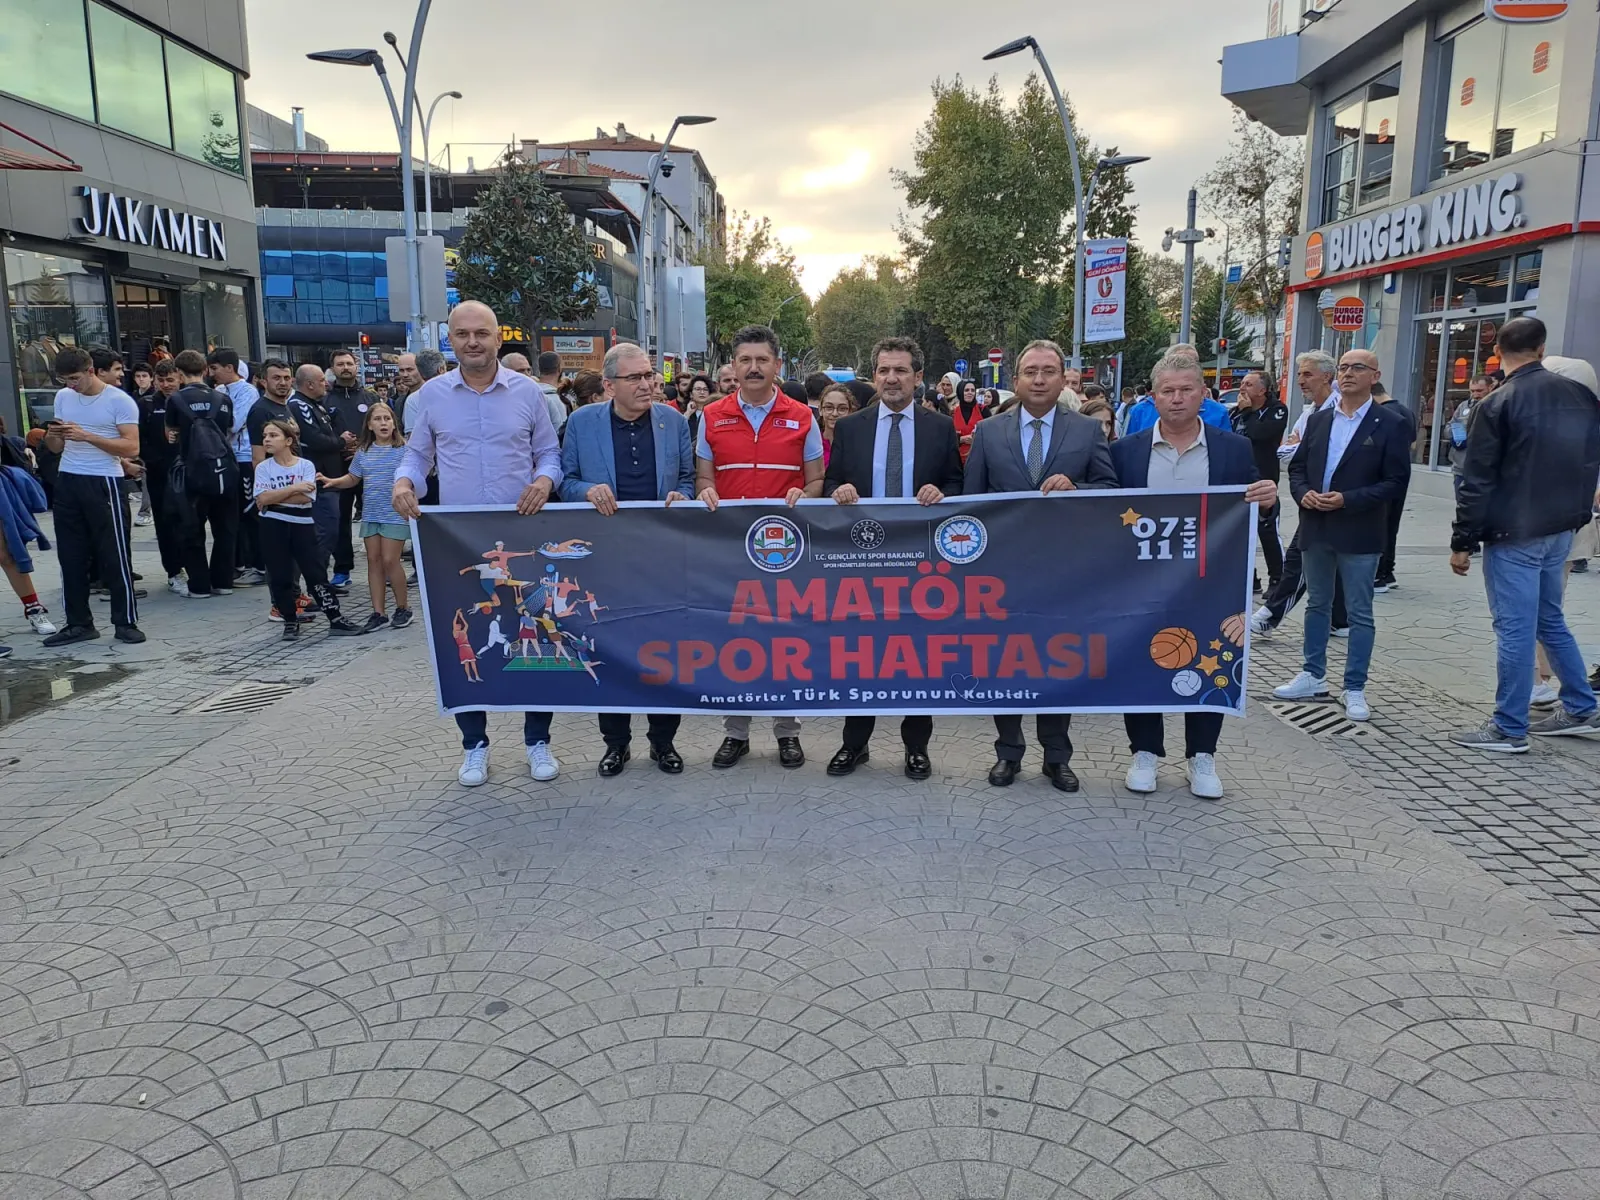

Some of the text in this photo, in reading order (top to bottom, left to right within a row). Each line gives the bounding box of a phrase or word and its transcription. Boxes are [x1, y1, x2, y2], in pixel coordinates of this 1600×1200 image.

[81, 186, 227, 261] JAKAMEN
[1328, 203, 1423, 272] BURGER
[1333, 314, 1364, 324] KING
[1132, 517, 1179, 538] 07
[1180, 517, 1197, 559] EKİM
[828, 552, 857, 561] GENÇLİK
[1137, 540, 1173, 560] 11
[727, 561, 1008, 624] AMATÖR
[636, 633, 1108, 685] SPOR HAFTASI
[700, 688, 1040, 704] Amatörler Türk Sporunun Kalbidir
